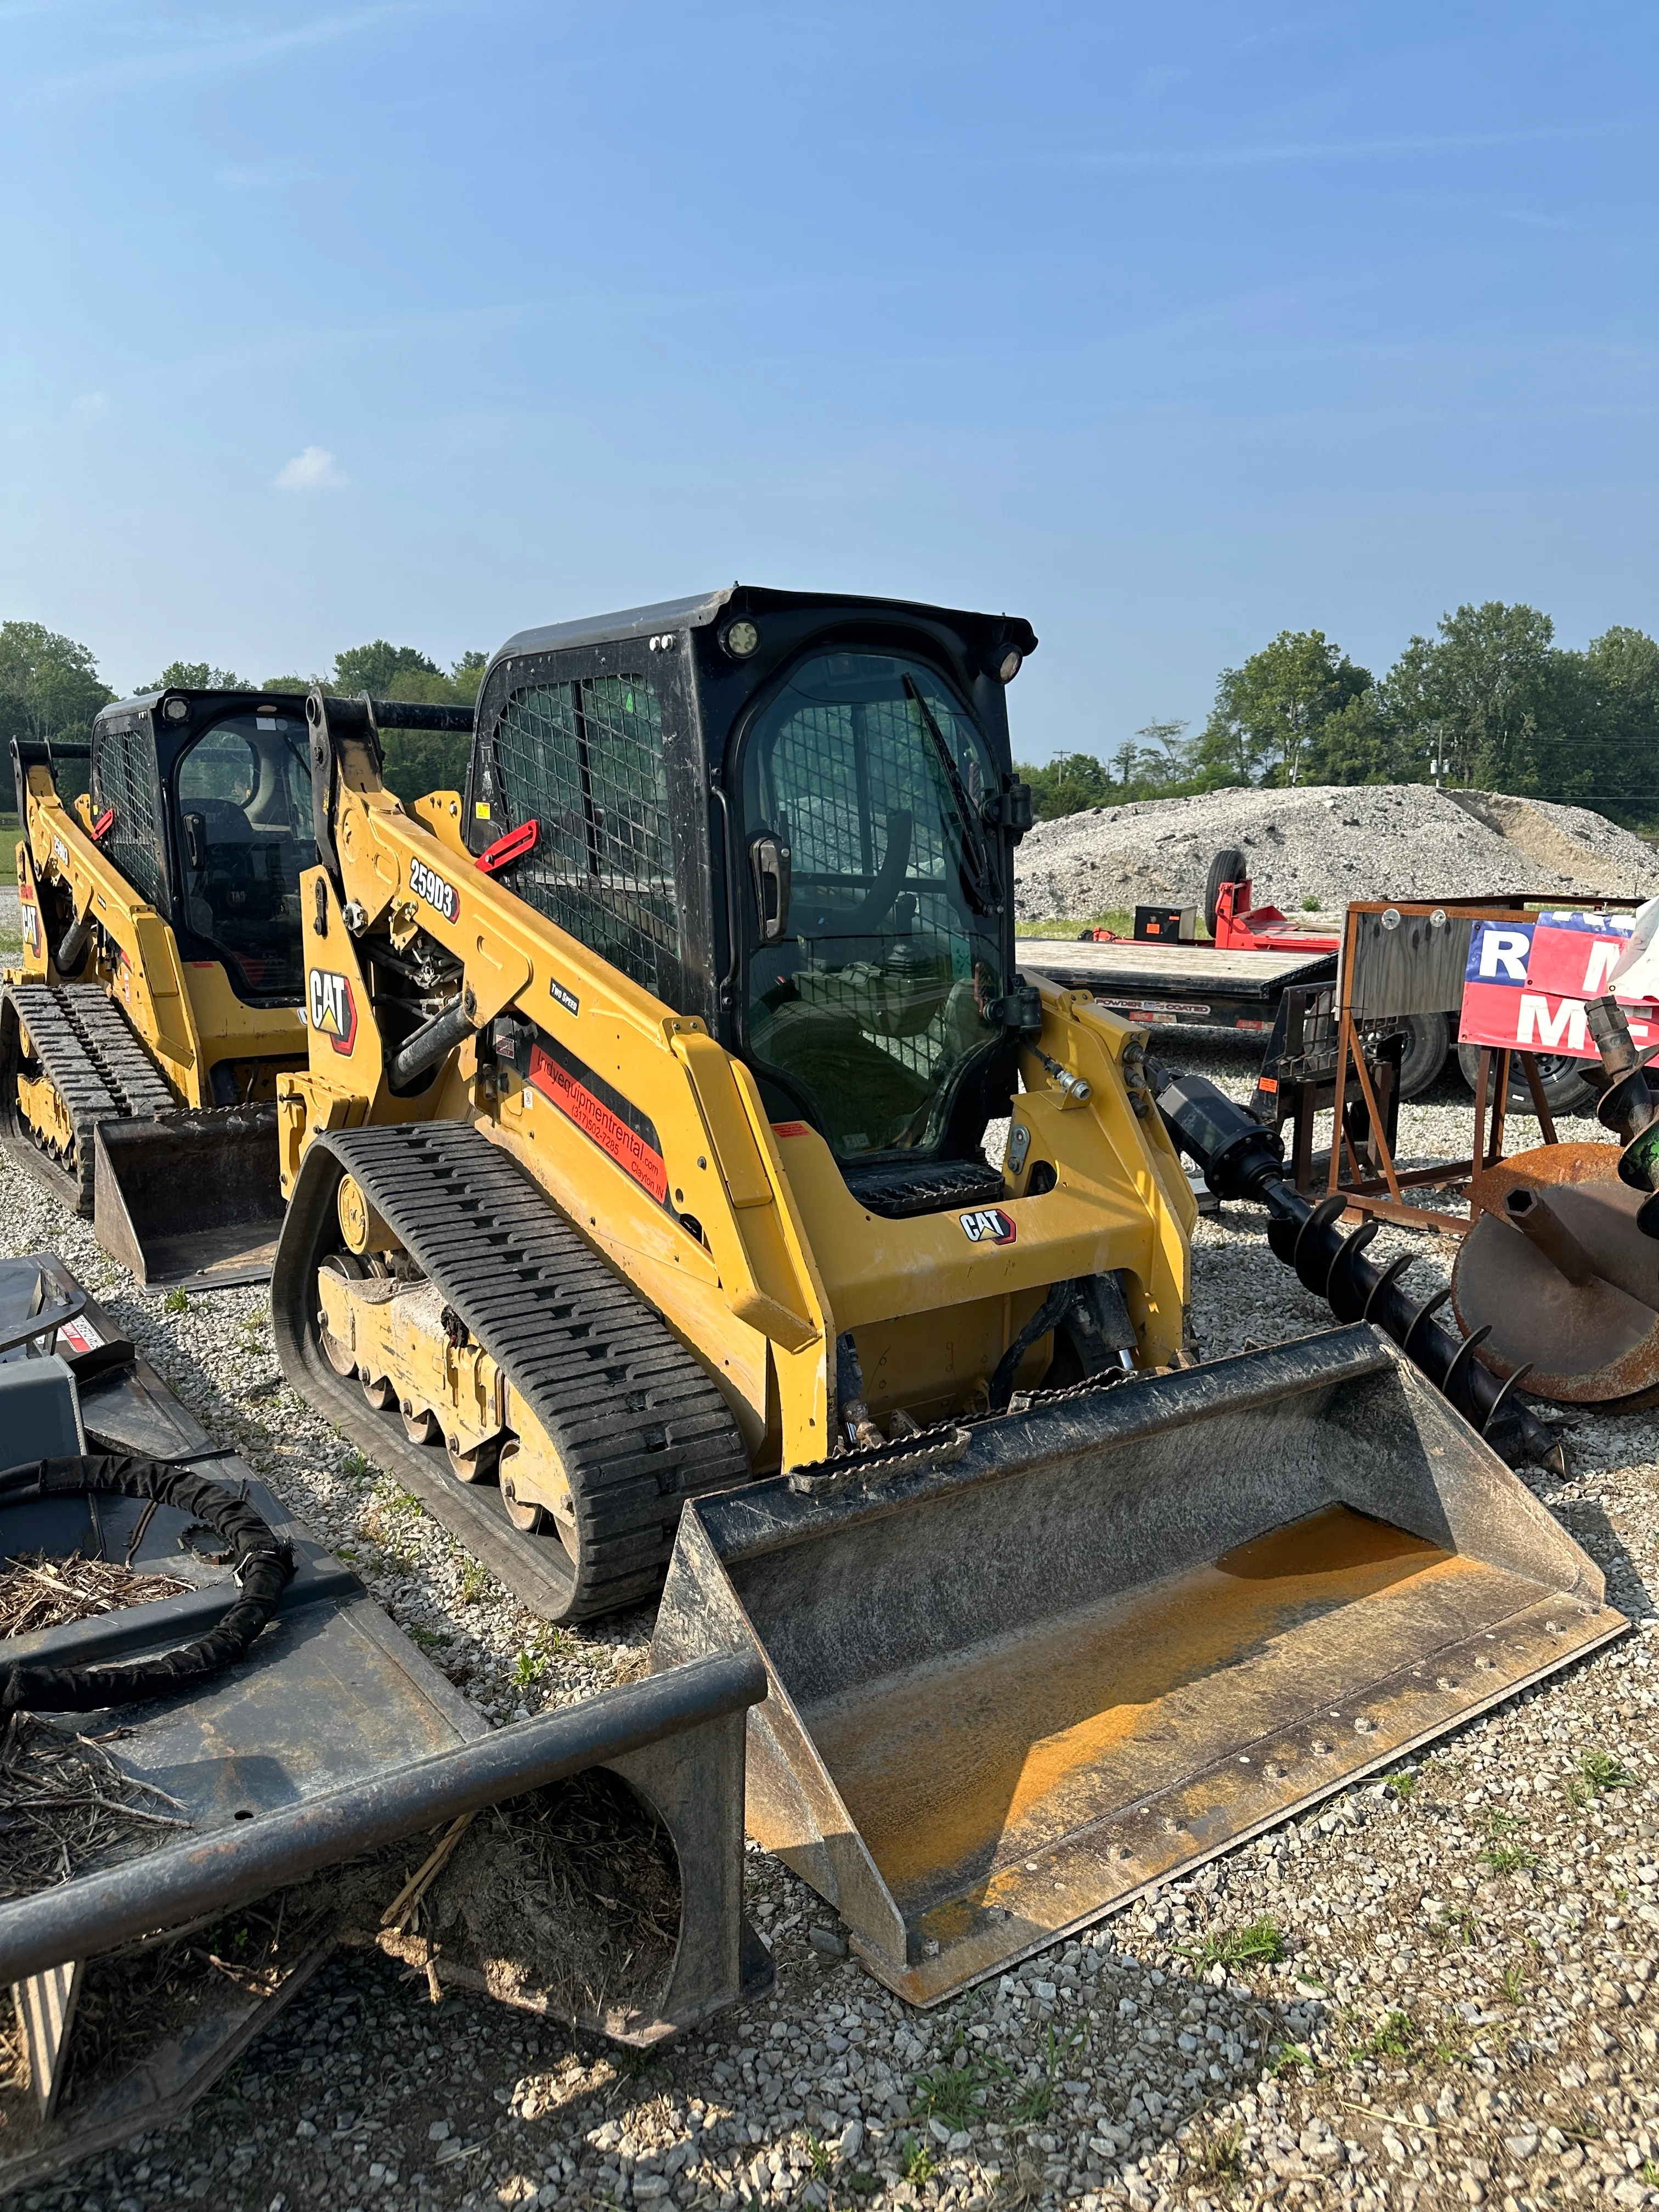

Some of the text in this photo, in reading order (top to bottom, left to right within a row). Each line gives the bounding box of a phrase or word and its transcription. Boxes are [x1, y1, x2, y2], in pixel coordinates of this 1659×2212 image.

[410, 859, 453, 917] 259D3
[21, 905, 37, 945] CAT
[309, 970, 345, 1036] CAT
[1096, 999, 1142, 1007] POWDER
[1165, 1004, 1209, 1012] COATED
[572, 1104, 619, 1155] (317)502-7285
[631, 1161, 664, 1198] Clayton IN
[960, 1210, 1005, 1241] CAT
